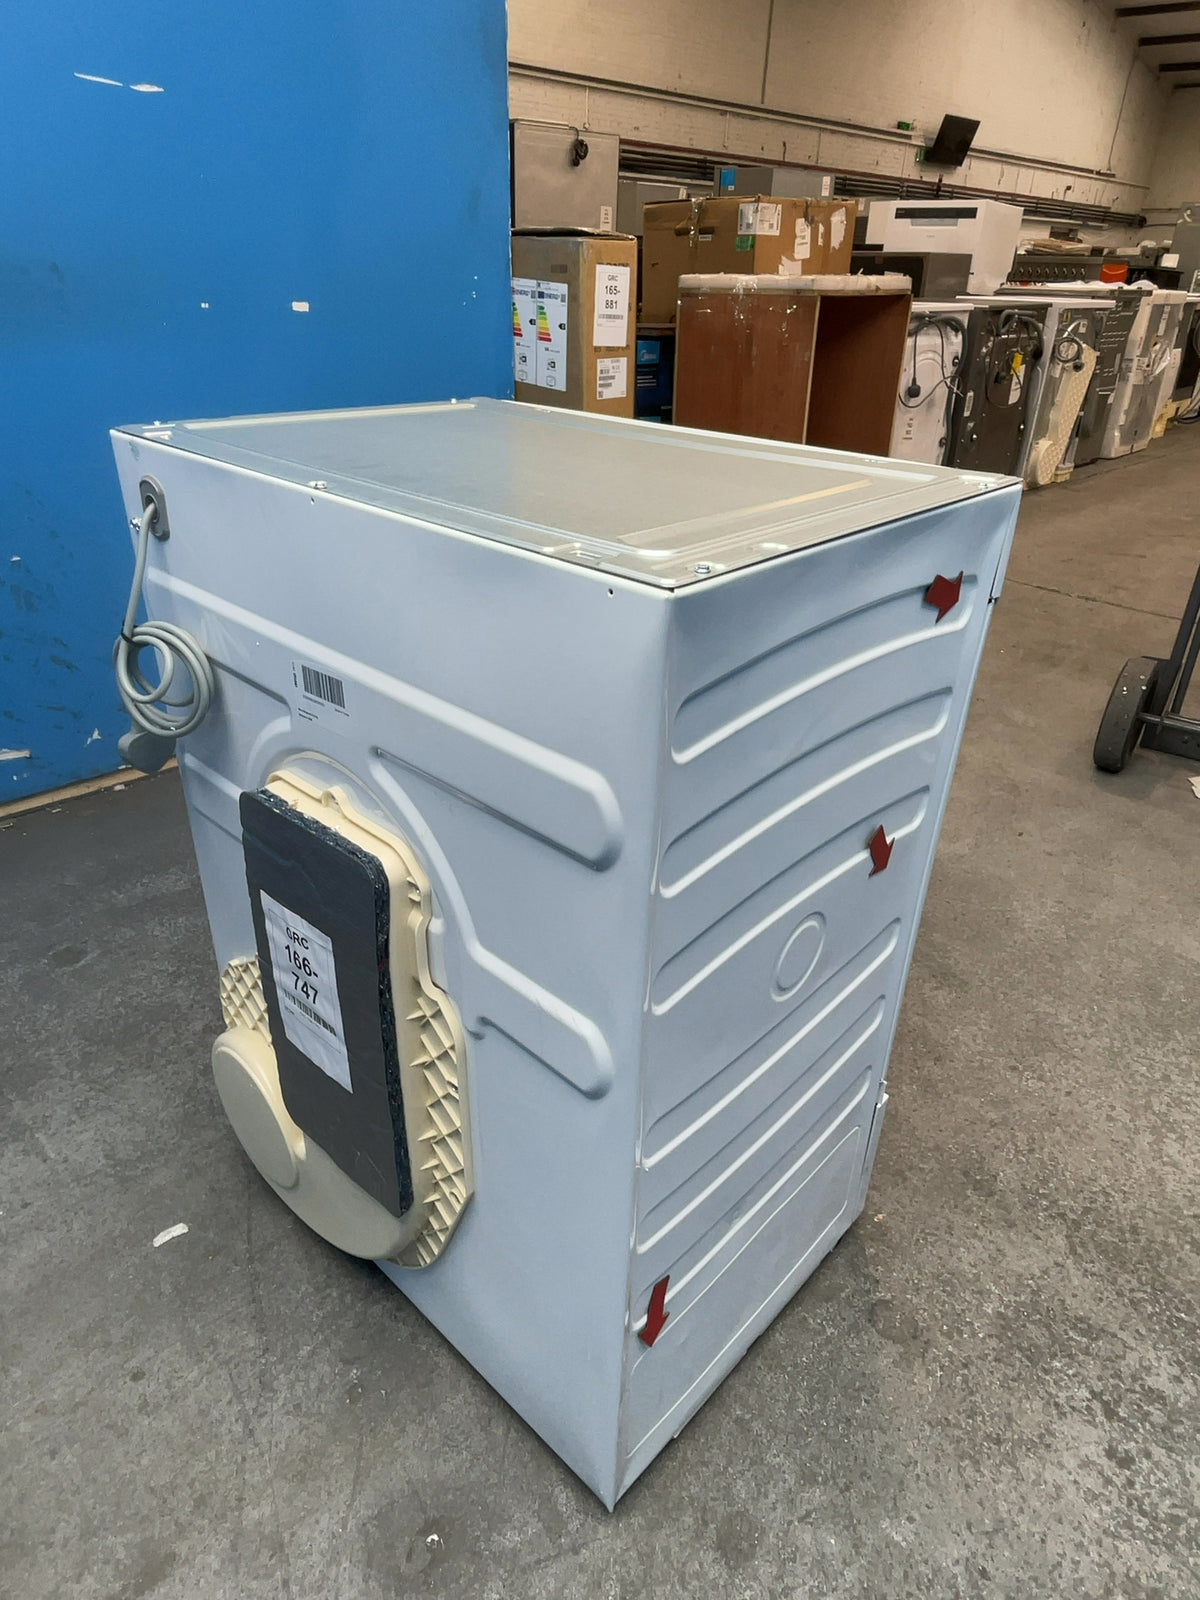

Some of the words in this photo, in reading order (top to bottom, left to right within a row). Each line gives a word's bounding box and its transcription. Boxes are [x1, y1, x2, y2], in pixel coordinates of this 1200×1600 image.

[604, 285, 621, 295] 165-
[604, 299, 618, 310] 881
[285, 926, 310, 950] GRC
[284, 943, 319, 978] 166-
[291, 971, 319, 1005] 747
